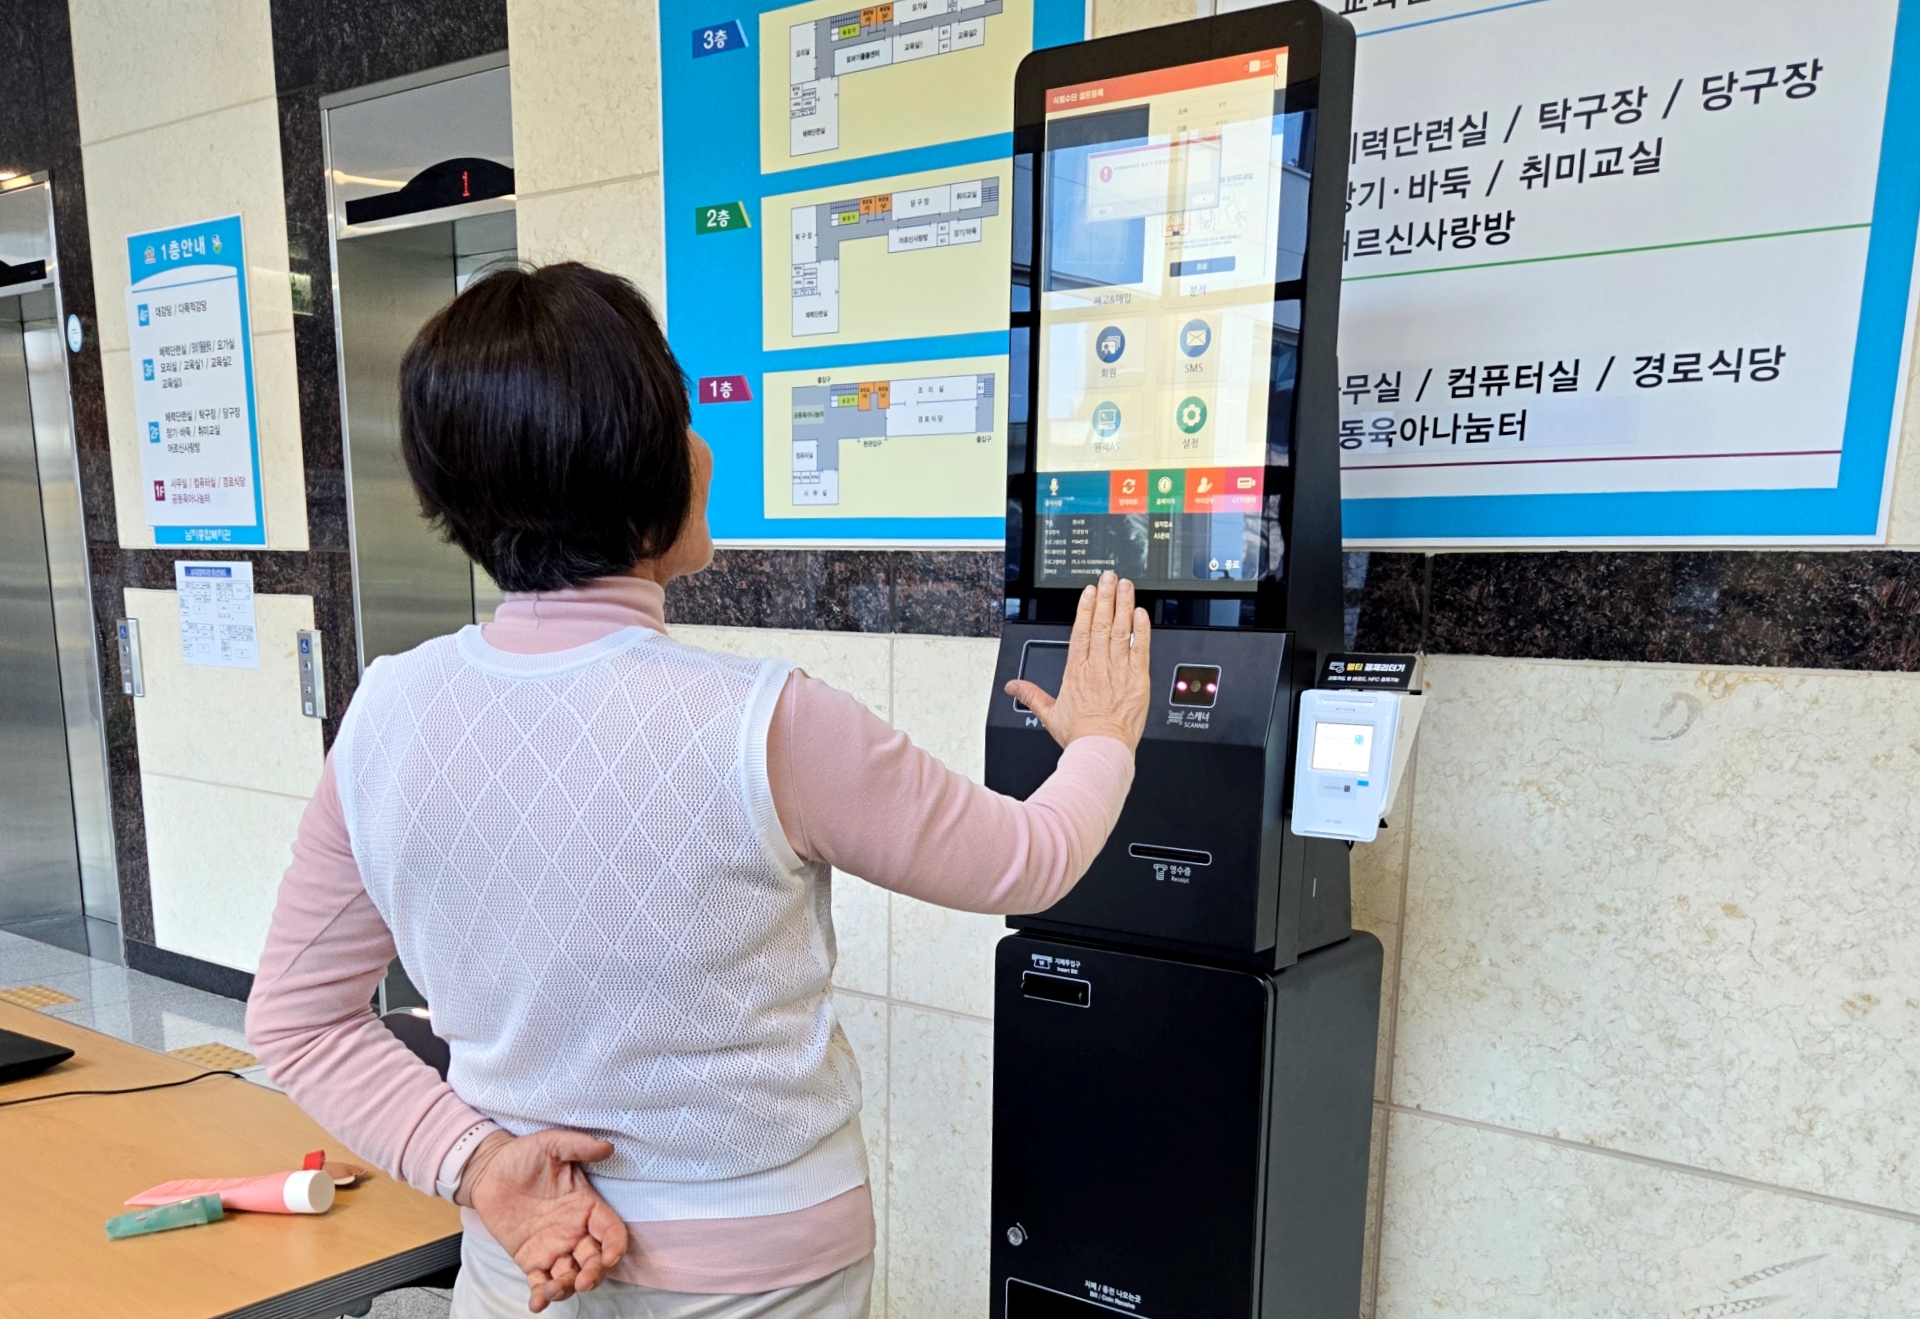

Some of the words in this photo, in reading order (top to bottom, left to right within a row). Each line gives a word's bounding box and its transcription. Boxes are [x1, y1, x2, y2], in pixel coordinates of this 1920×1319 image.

[703, 29, 728, 49] 3층
[1349, 110, 1488, 165] 력단련실
[1538, 86, 1648, 134] 탁구장
[1701, 58, 1824, 111] 당구장
[1519, 137, 1663, 190] 취미교실
[462, 171, 470, 197] 1
[706, 209, 731, 227] 2층
[161, 235, 206, 261] 1층안내
[155, 304, 172, 317] 대강당
[217, 338, 235, 350] 요가실
[160, 360, 177, 373] 요리실
[1100, 367, 1117, 379] 회원
[1184, 363, 1204, 374] SMS
[817, 376, 831, 384] 출입구
[1338, 371, 1402, 405] 무실
[1447, 358, 1580, 399] 컴퓨터실
[1632, 344, 1786, 389] 경로식당
[709, 380, 733, 399] 1층
[198, 408, 216, 420] 탁구장
[222, 407, 241, 419] 당구장
[198, 424, 221, 436] 취미교실
[976, 435, 992, 443] 출입구
[1182, 438, 1199, 449] 설정
[171, 477, 188, 489] 사무실
[193, 477, 216, 488] 컴퓨터실
[222, 476, 246, 488] 경로식당
[155, 485, 165, 498] 1F
[1224, 559, 1240, 569] 종료
[1184, 721, 1210, 729] SCANNER
[1169, 865, 1192, 877] 영수증
[1171, 876, 1190, 884] Receipt
